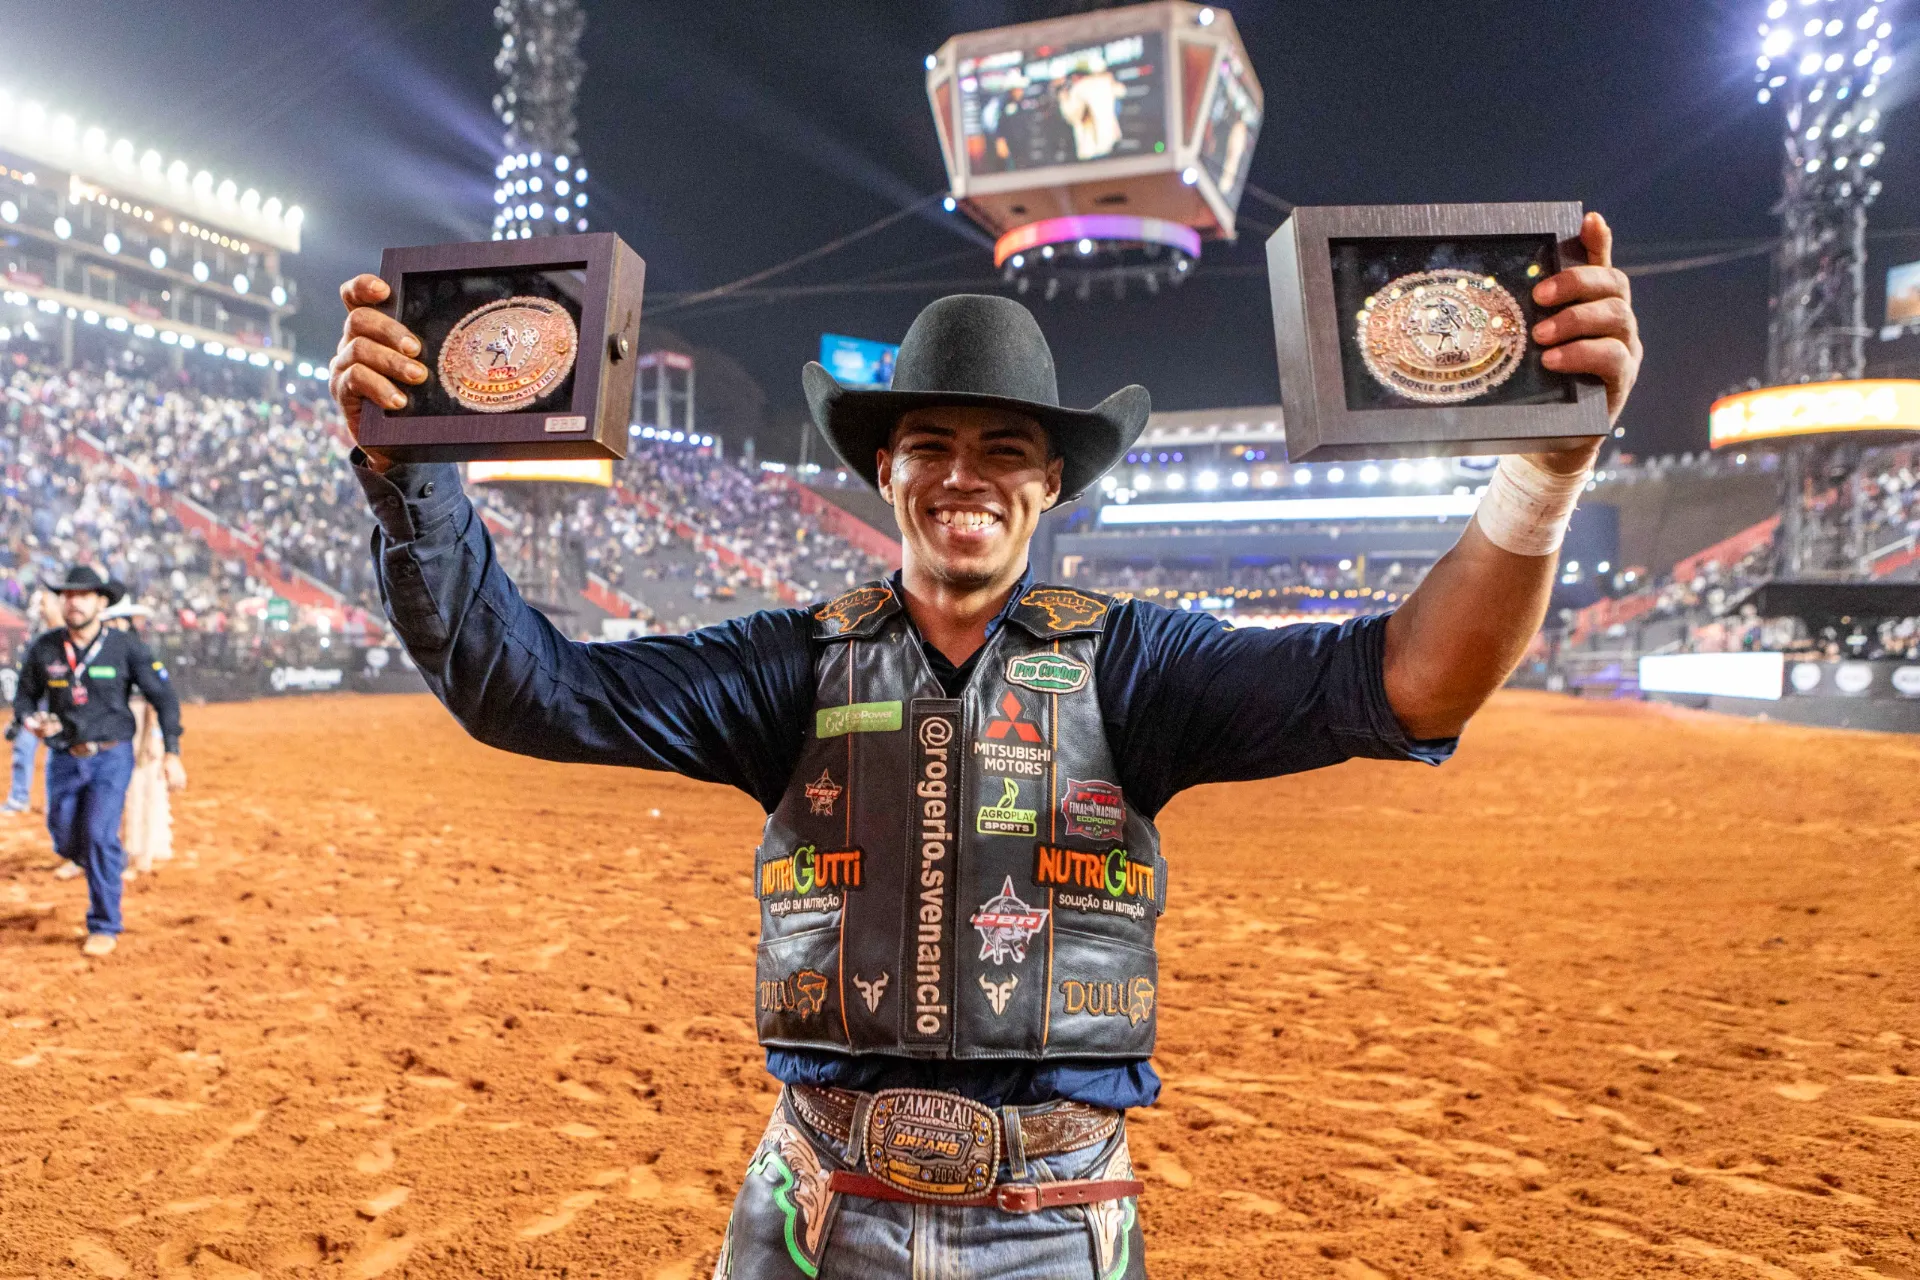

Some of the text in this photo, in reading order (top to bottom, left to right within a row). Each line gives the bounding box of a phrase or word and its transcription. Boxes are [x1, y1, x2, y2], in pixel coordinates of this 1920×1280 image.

[488, 366, 518, 379] 2024
[1391, 353, 1512, 393] ROOKIE OF THE YEAR
[502, 368, 557, 402] BRASILEIRO
[1013, 662, 1083, 683] Pro Cowboy
[974, 742, 1051, 762] MITSUBISHI
[984, 757, 1043, 775] MOTORS
[981, 809, 1035, 821] AGROPLAY
[1069, 801, 1122, 820] FINAL NACIONAL
[1076, 815, 1116, 826] ECOPOWER
[984, 821, 1030, 832] SPORTS
[915, 716, 953, 1035] @rogerio.svenancio
[770, 894, 840, 915] SOLUÇÃO EM NUTRIÇÃO
[1060, 894, 1145, 919] SOLUÇÃO EM NUTRIÇÃO
[976, 914, 1037, 926] PBR
[760, 975, 796, 1011] DULU
[1062, 978, 1134, 1014] DULU
[901, 1125, 957, 1143] ARENA
[893, 1133, 961, 1156] DREAMS
[935, 1163, 961, 1182] 2024
